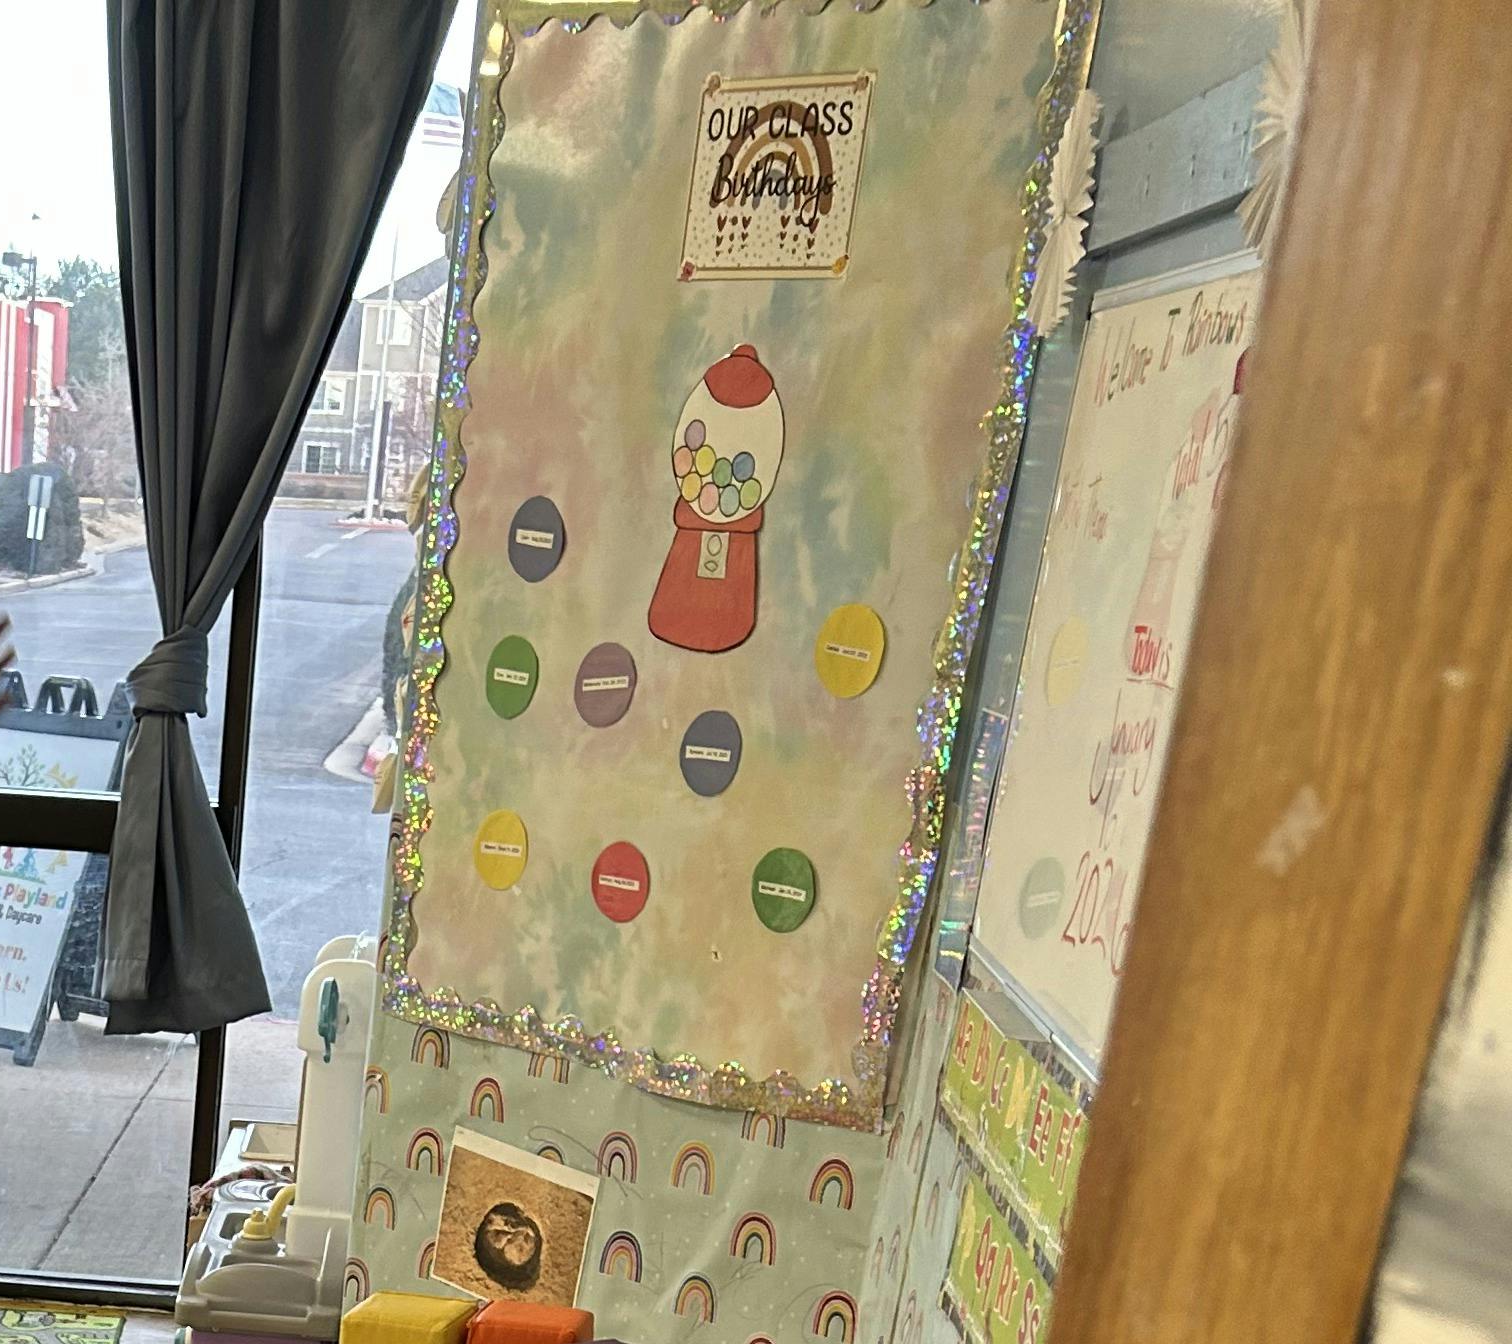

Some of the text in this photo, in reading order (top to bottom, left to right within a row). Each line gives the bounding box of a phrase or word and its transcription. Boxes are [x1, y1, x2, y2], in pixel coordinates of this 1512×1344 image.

[708, 100, 855, 142] OUR CLASS
[712, 150, 837, 228] Birthdays
[3, 882, 69, 910] Playland
[5, 905, 43, 926] Daycare
[1028, 1081, 1054, 1167] Ee
